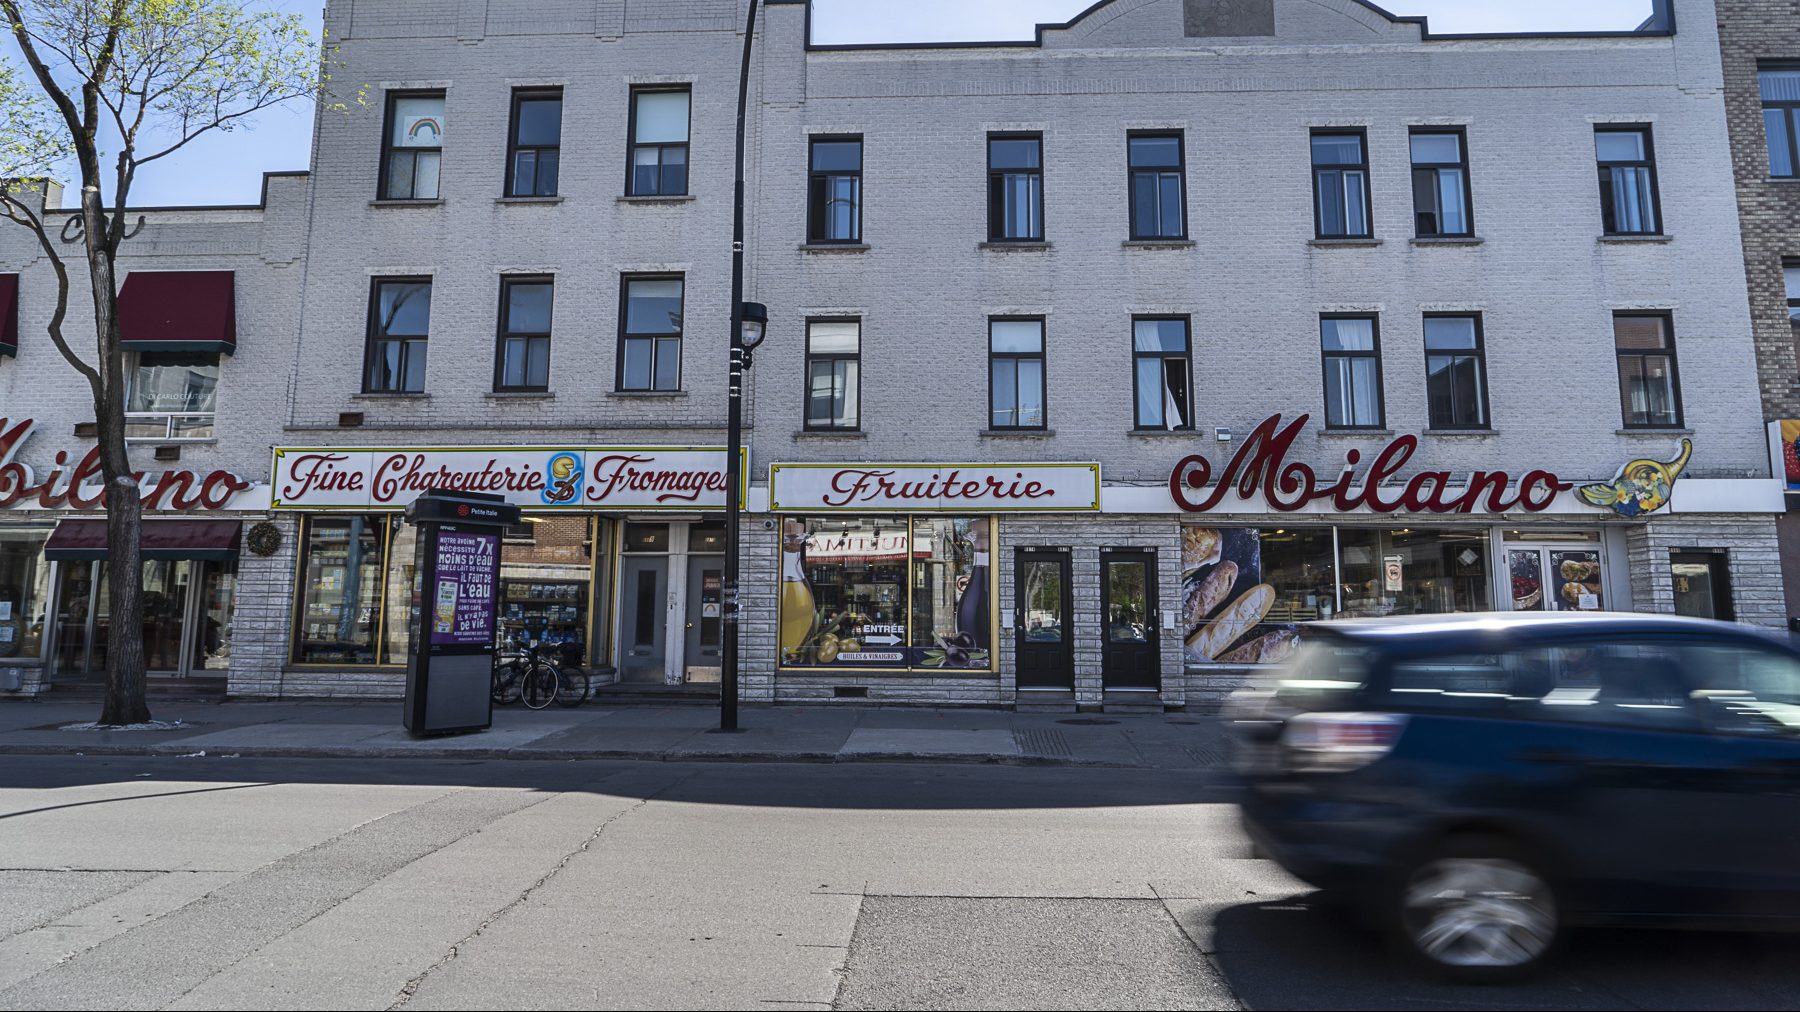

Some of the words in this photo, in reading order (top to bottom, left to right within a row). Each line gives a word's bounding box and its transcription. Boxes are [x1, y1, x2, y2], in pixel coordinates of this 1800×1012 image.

[283, 453, 364, 501] Fine
[372, 454, 546, 502] Charcuterie
[1168, 413, 1574, 514] Milano
[822, 469, 1055, 507] Fruiterie
[471, 508, 486, 516] Petite
[863, 623, 905, 634] ENTRÉE
